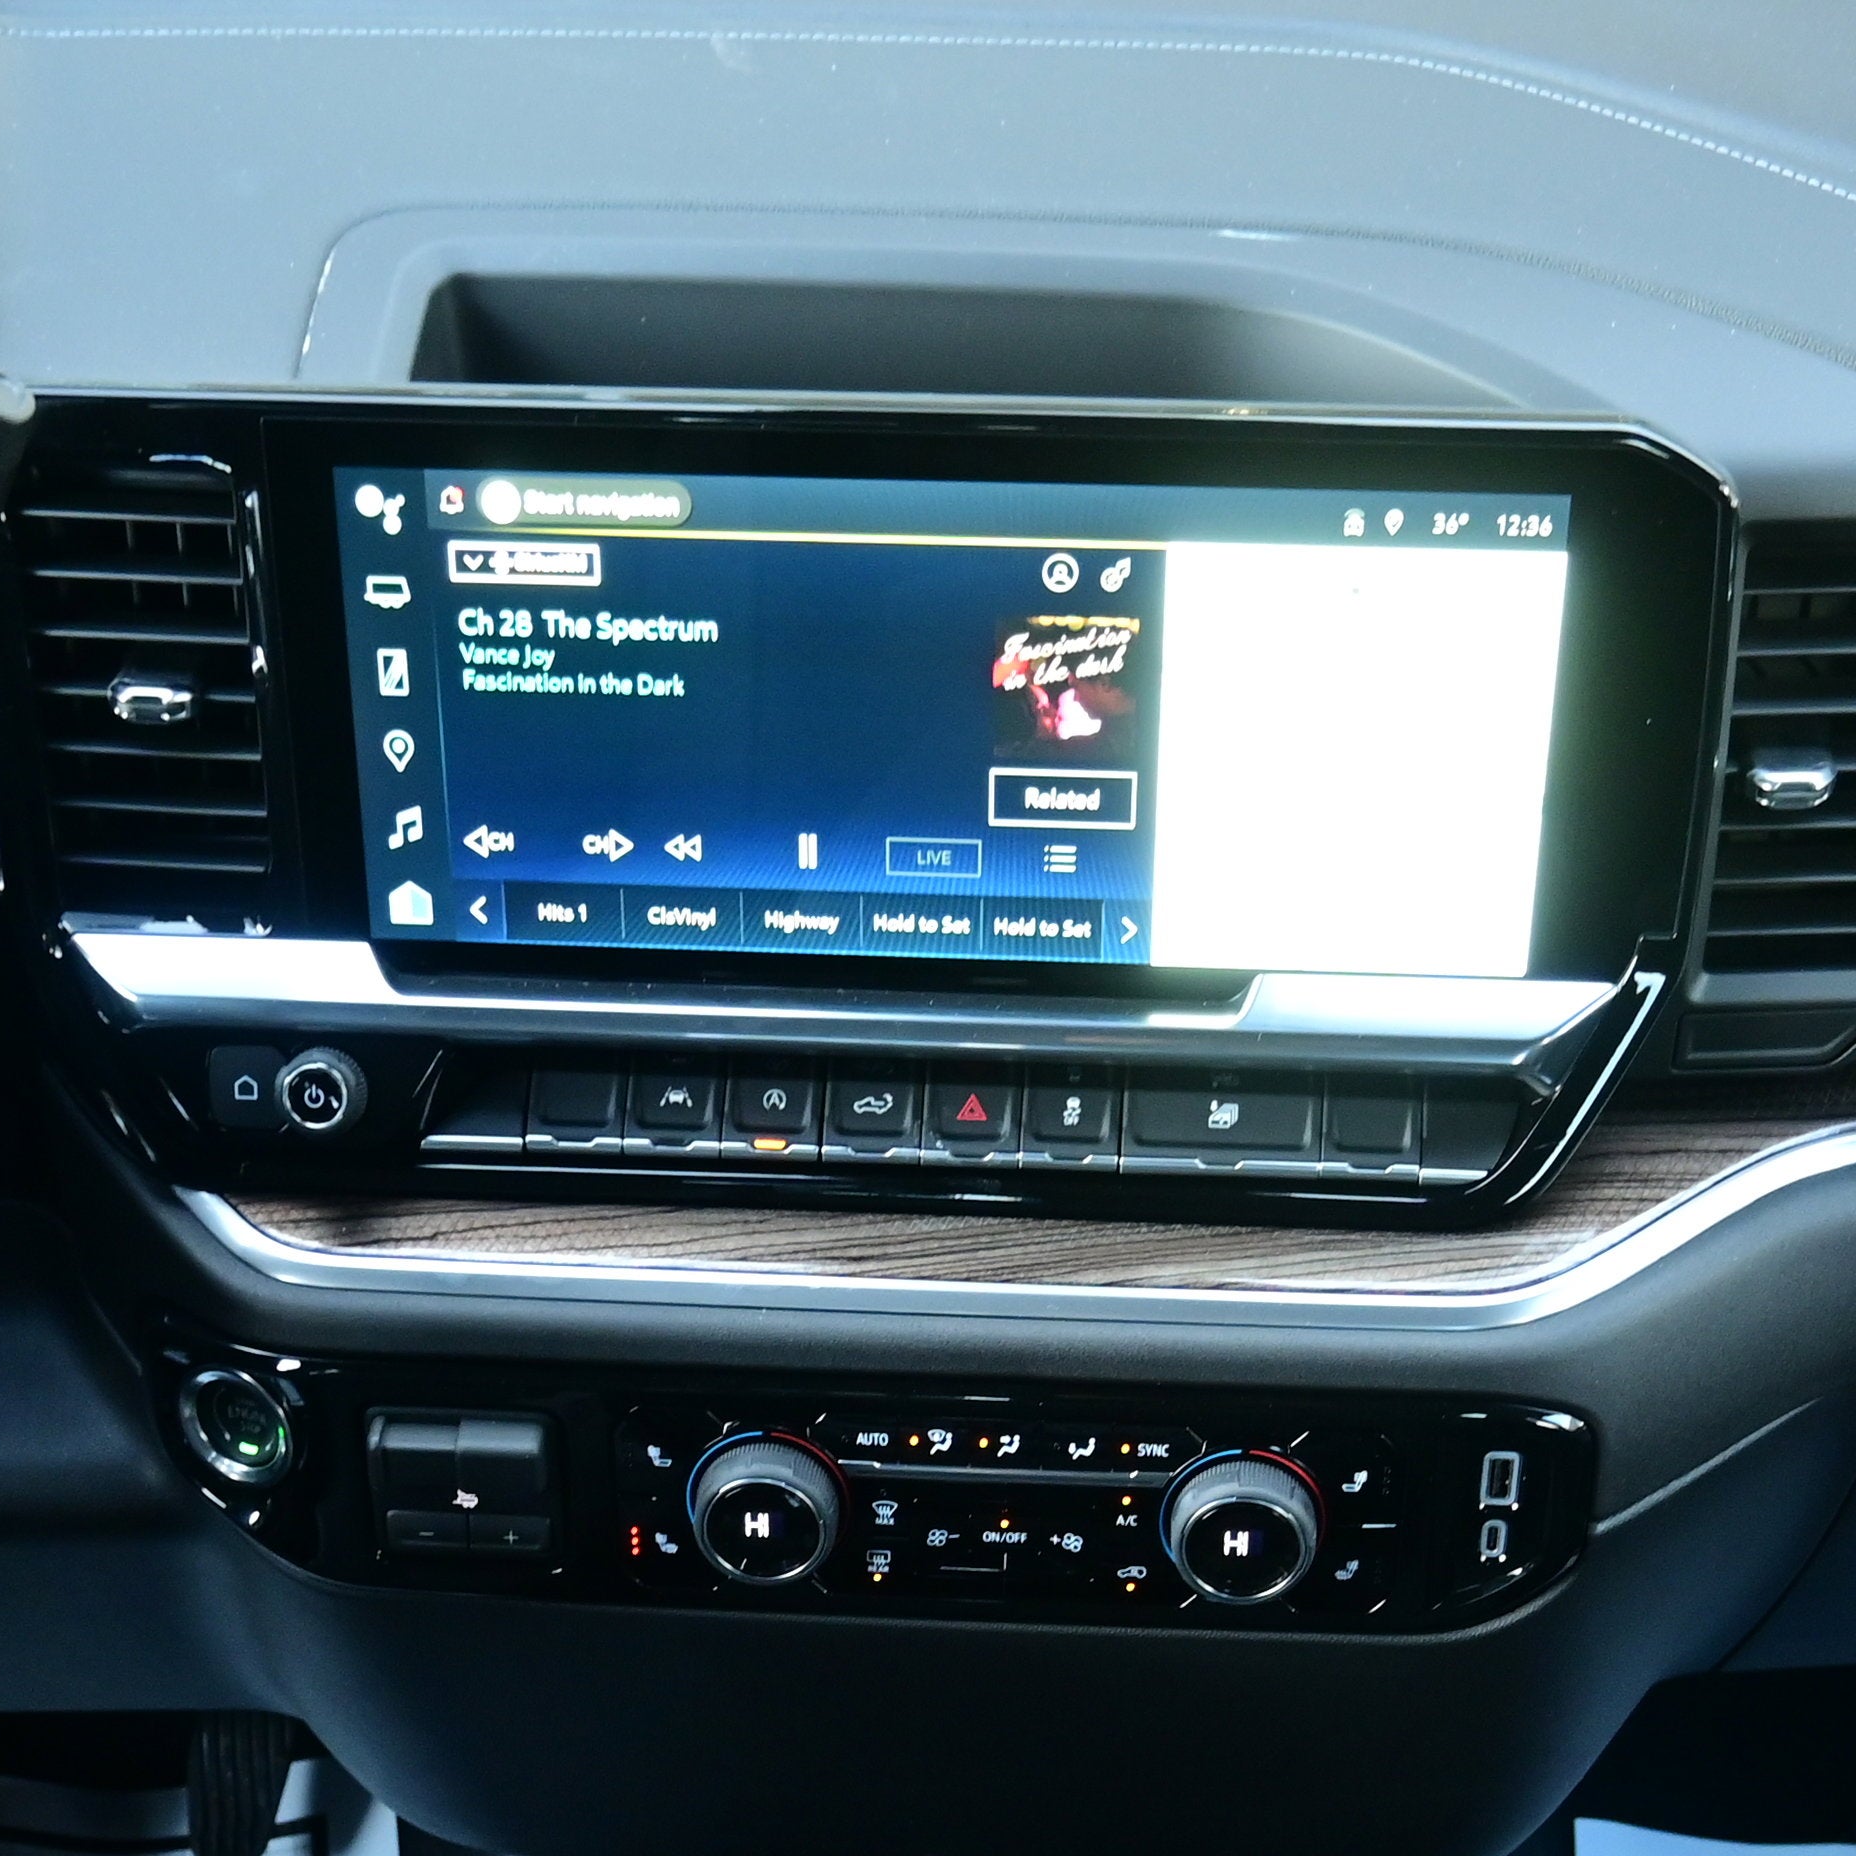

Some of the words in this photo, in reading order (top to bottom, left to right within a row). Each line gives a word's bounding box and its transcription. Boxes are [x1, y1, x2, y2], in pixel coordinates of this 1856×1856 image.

[1497, 513, 1553, 537] 12:36
[458, 607, 494, 636] Ch
[499, 609, 533, 638] 28
[541, 609, 591, 640] The
[596, 611, 719, 646] Spectrum
[459, 642, 520, 665] Vance
[523, 644, 555, 671] Joy
[462, 668, 574, 694] Fascination
[578, 673, 596, 694] in
[599, 672, 632, 696] the
[637, 672, 685, 697] Dark
[1025, 786, 1100, 811] Related
[488, 832, 514, 851] CH
[583, 834, 609, 854] CH
[917, 849, 951, 866] LIVE
[765, 909, 840, 935] Highway
[873, 913, 915, 932] Hold
[918, 914, 938, 933] to
[941, 915, 971, 934] Set
[994, 916, 1036, 936] Hold
[1039, 918, 1059, 937] to
[1062, 919, 1092, 938] Set
[856, 1432, 889, 1446] AUTO
[1136, 1443, 1170, 1458] SYNC
[744, 1511, 770, 1539] HI
[1116, 1515, 1138, 1527] A/C
[982, 1531, 1028, 1544] ON/OFF
[1223, 1530, 1249, 1557] HI
